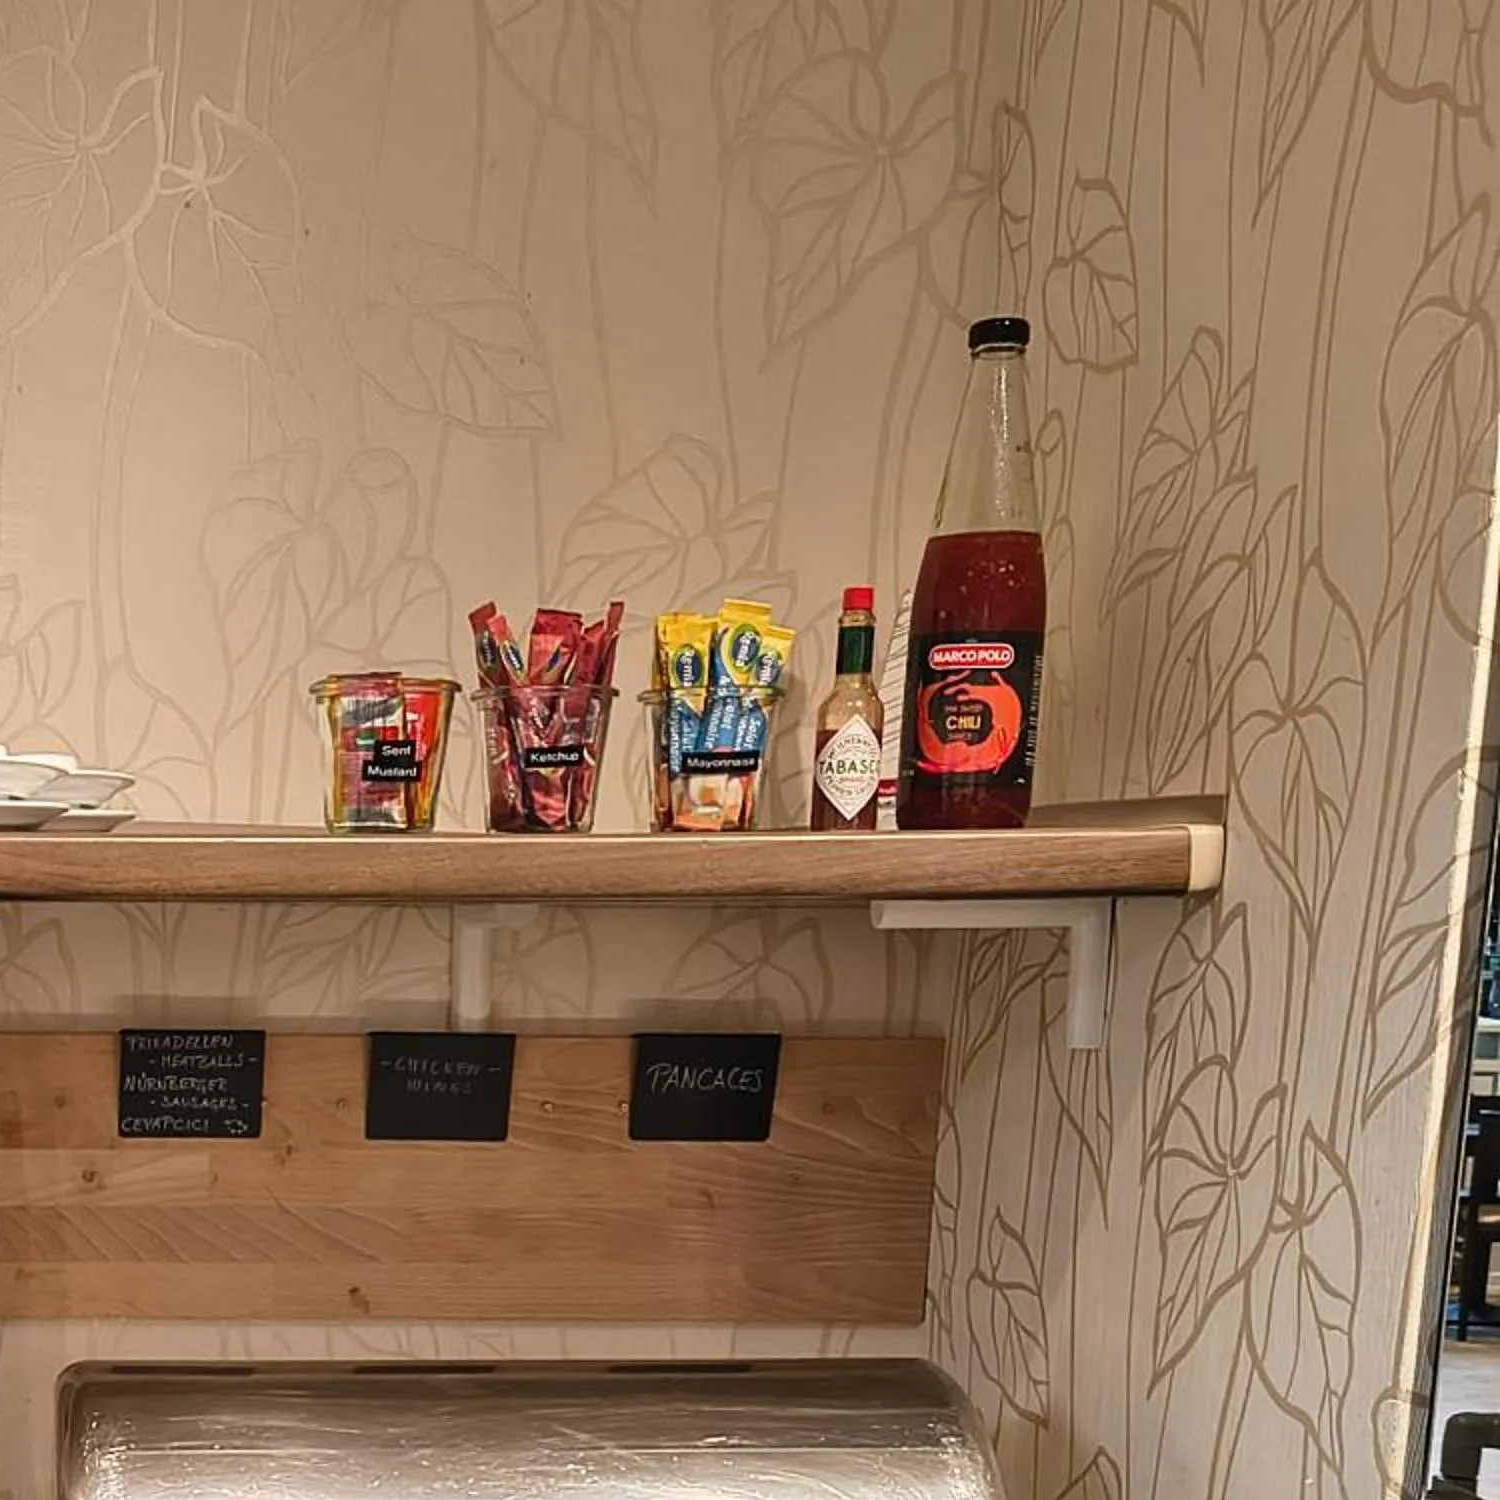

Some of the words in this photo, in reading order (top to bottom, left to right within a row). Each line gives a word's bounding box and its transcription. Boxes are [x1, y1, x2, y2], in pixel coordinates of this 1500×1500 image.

[933, 650, 977, 663] MARCO
[977, 649, 1011, 661] POLO
[530, 751, 579, 763] Ketchup
